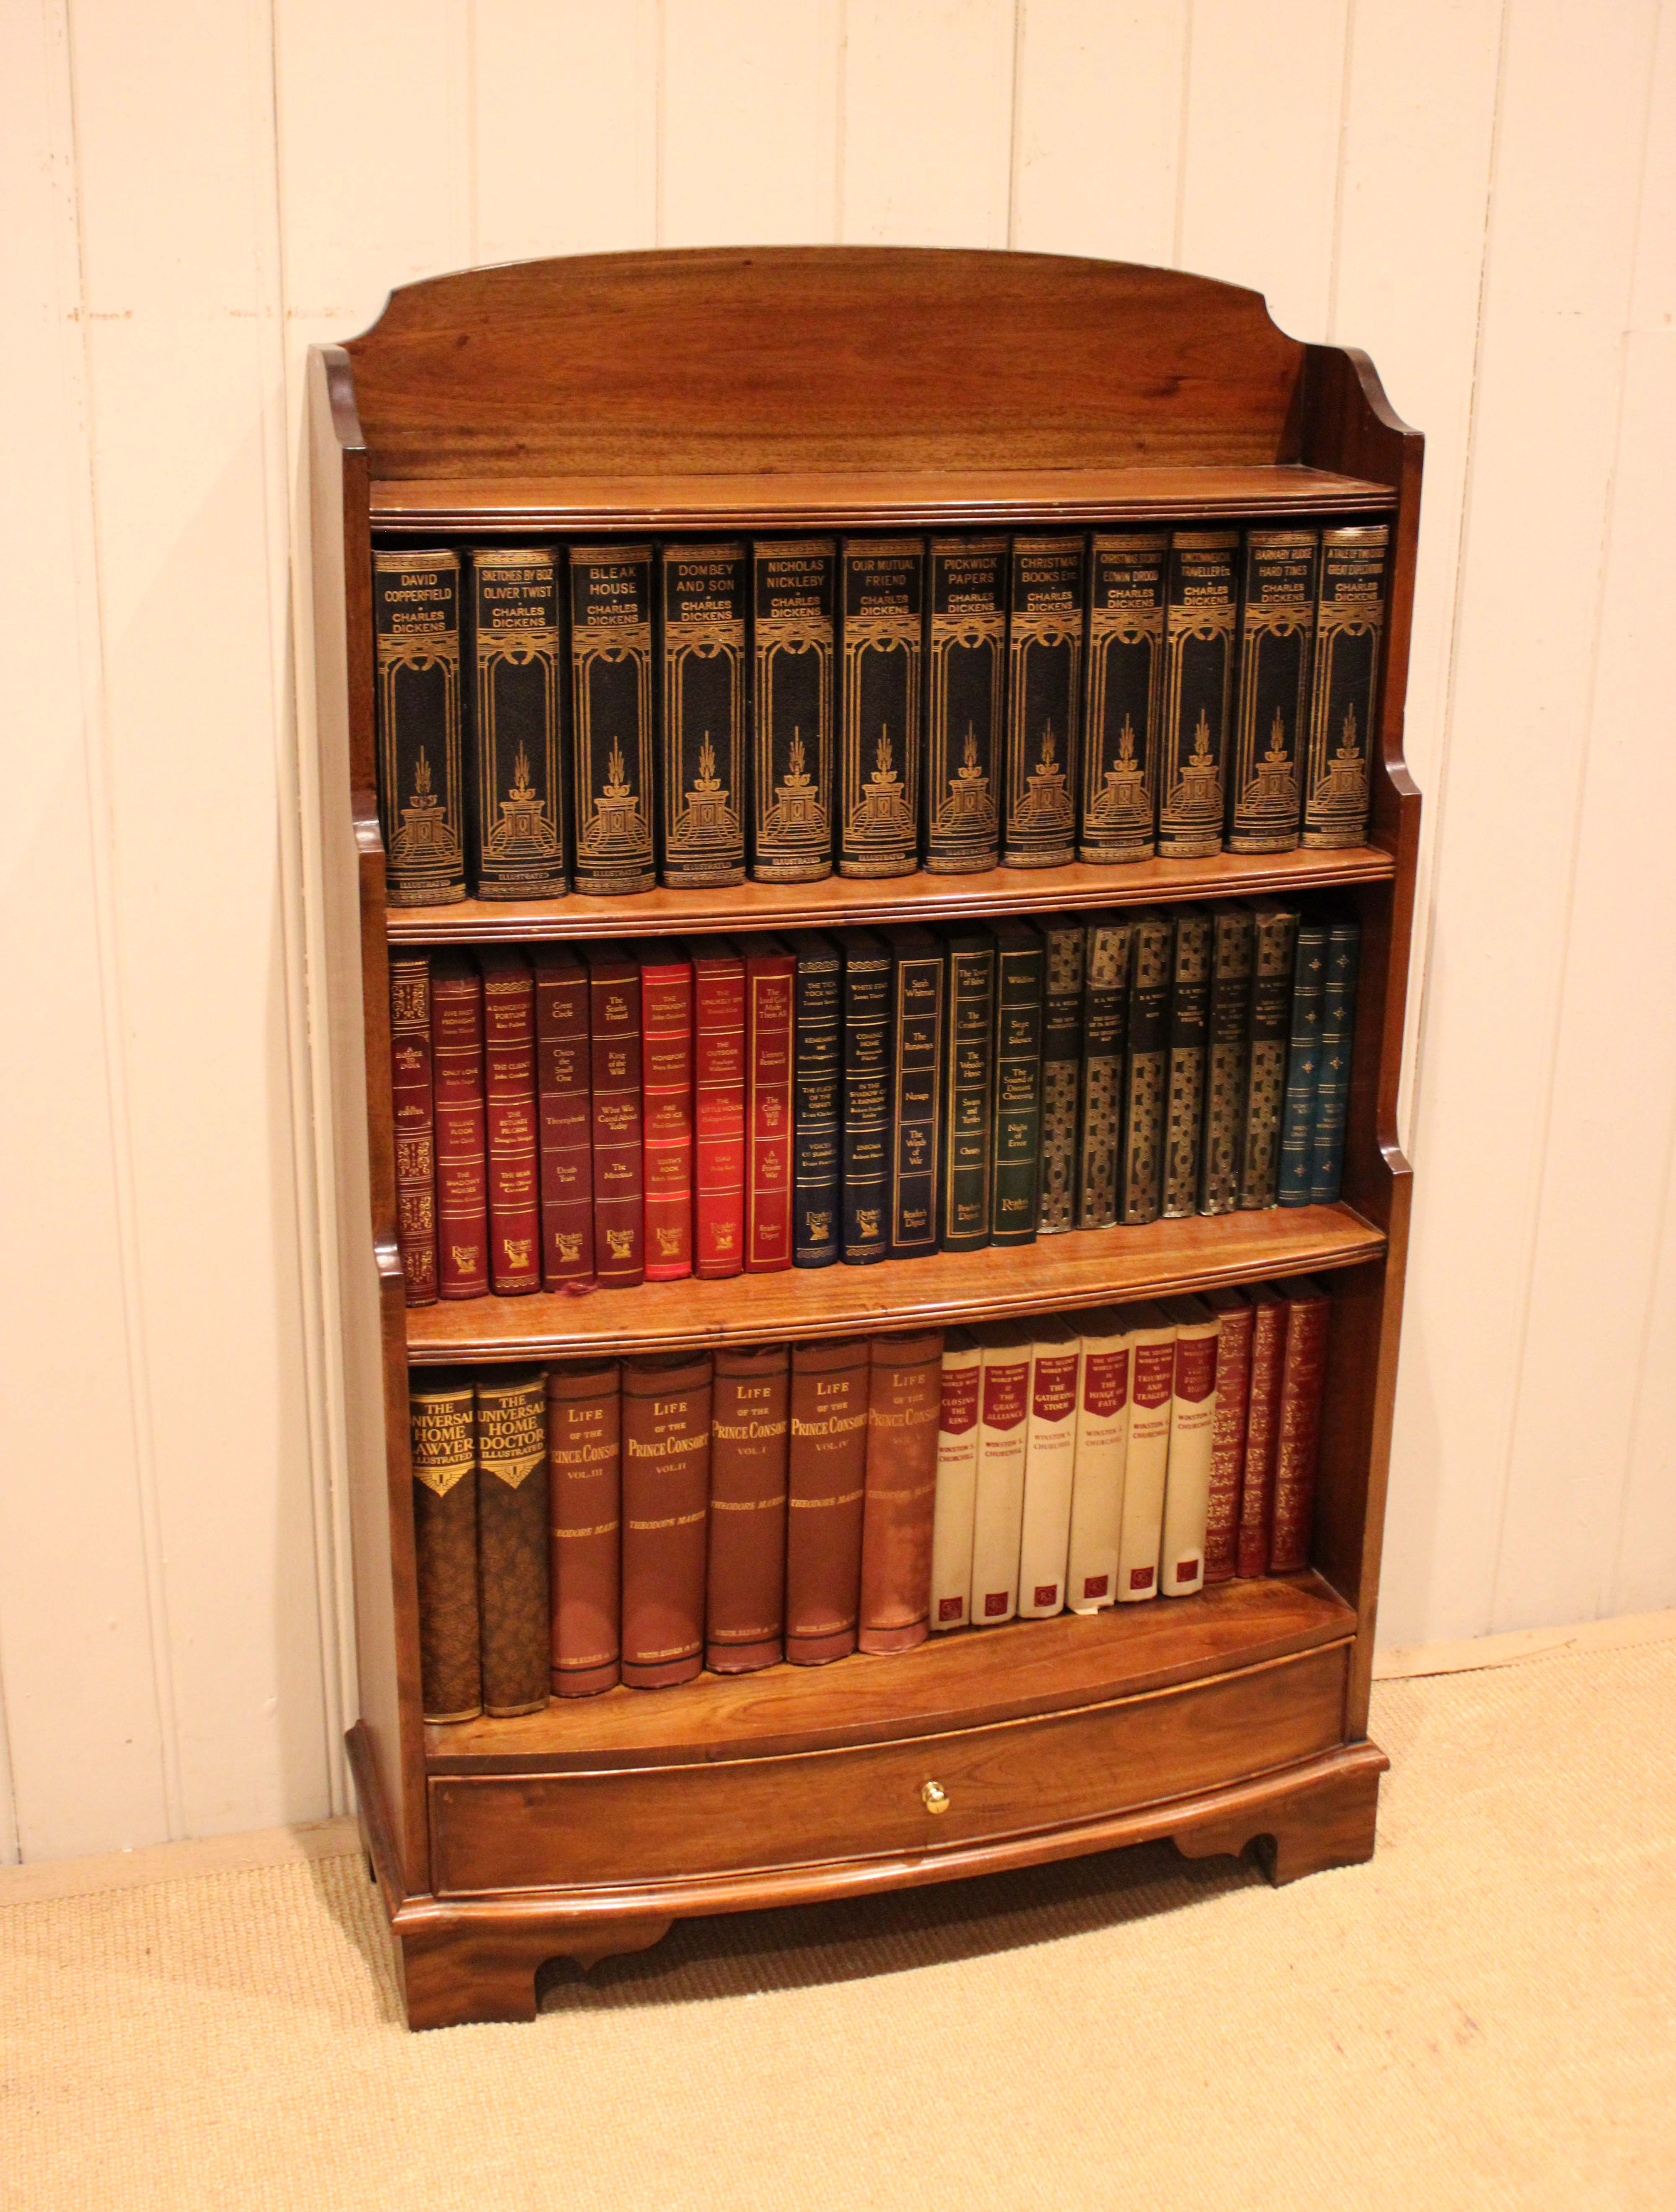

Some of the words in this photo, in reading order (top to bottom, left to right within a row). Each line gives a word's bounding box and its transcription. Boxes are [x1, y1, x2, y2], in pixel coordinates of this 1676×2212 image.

[1254, 549, 1289, 560] BARNABY
[768, 560, 824, 572] NICHOLAS
[852, 560, 875, 571] OUR
[877, 559, 914, 570] MUTUAL
[944, 558, 997, 570] PICKWICK
[1021, 556, 1078, 568] CHRISTMAS
[482, 570, 522, 581] SKETCHES
[524, 570, 535, 580] BY
[590, 567, 636, 579] BLEAK
[678, 564, 734, 576] DOMBEY
[1259, 566, 1282, 576] HARD
[1284, 565, 1307, 576] TIMES
[401, 574, 437, 586] DAVID
[767, 575, 825, 588] NICKLEBY
[865, 575, 907, 587] FRIEND
[949, 572, 994, 584] PAPERS
[1022, 571, 1059, 582] BOOKS
[590, 582, 637, 595] HOUSE
[676, 581, 704, 592] AND
[709, 580, 735, 591] SON
[1184, 586, 1229, 595] CHARLES
[1262, 584, 1304, 592] CHARLES
[1335, 582, 1378, 592] CHARLES
[385, 588, 452, 602] COPPERFIELD
[484, 587, 519, 599] OLIVER
[523, 586, 552, 598] TWIST
[949, 592, 995, 602] CHARLES
[1027, 592, 1072, 601] CHARLES
[1108, 589, 1154, 598] CHARLES
[1262, 593, 1305, 602] DICKENS
[1335, 592, 1378, 601] DICKENS
[681, 600, 732, 611] CHARLES
[771, 596, 821, 607] CHARLES
[861, 595, 908, 605] CHARLES
[1107, 599, 1154, 608] DICKENS
[1184, 596, 1229, 605] DICKENS
[492, 607, 545, 617] CHARLES
[587, 604, 637, 614] CHARLES
[771, 607, 821, 618] DICKENS
[861, 606, 909, 615] DICKENS
[948, 603, 995, 613] DICKENS
[1027, 602, 1073, 612] DICKENS
[392, 611, 445, 623] CHARLES
[587, 615, 638, 625] DICKENS
[681, 611, 732, 621] DICKENS
[393, 622, 445, 633] DICKENS
[492, 618, 545, 628] DICKENS
[772, 857, 820, 865] ILLUSTRATED
[858, 853, 905, 861] ILLUSTRATED
[683, 862, 732, 871] ILLUSTRATED
[593, 868, 642, 877] ILLUSTRATED
[400, 880, 450, 889] ILLUSTRATED
[913, 1032, 927, 1041] The
[909, 1130, 923, 1139] The
[893, 1374, 925, 1387] LIFE
[1137, 1373, 1170, 1382] TRIUMPH
[737, 1386, 771, 1399] LIFE
[817, 1382, 849, 1395] LIFE
[908, 1394, 924, 1403] THE
[1035, 1392, 1076, 1402] GATHERING
[1089, 1390, 1115, 1399] HINGE
[1136, 1391, 1169, 1401] TRAGEDY
[499, 1395, 526, 1408] THE
[830, 1402, 848, 1410] THE
[942, 1398, 975, 1406] CLOSING
[993, 1402, 1020, 1411] GRAND
[1043, 1402, 1069, 1411] STORM
[424, 1403, 454, 1415] THE
[478, 1401, 545, 1422] UNIVERSAL
[654, 1402, 687, 1416] LIFE
[569, 1409, 603, 1422] LIFE
[869, 1408, 904, 1426] PRINCE
[987, 1411, 1023, 1421] ALLIANCE
[489, 1417, 537, 1436] HOME
[713, 1420, 747, 1439] PRINCE
[791, 1419, 828, 1436] PRINCE
[830, 1413, 868, 1433] CONSORT
[415, 1426, 466, 1442] HOME
[480, 1429, 544, 1450] DOCTOR
[584, 1430, 603, 1439] THE
[416, 1438, 475, 1455] AWYER
[629, 1438, 665, 1457] PRINCE
[667, 1432, 709, 1454] CONSORT
[482, 1443, 543, 1458] ILLUSTRATED
[630, 1518, 674, 1530] THEODORE
